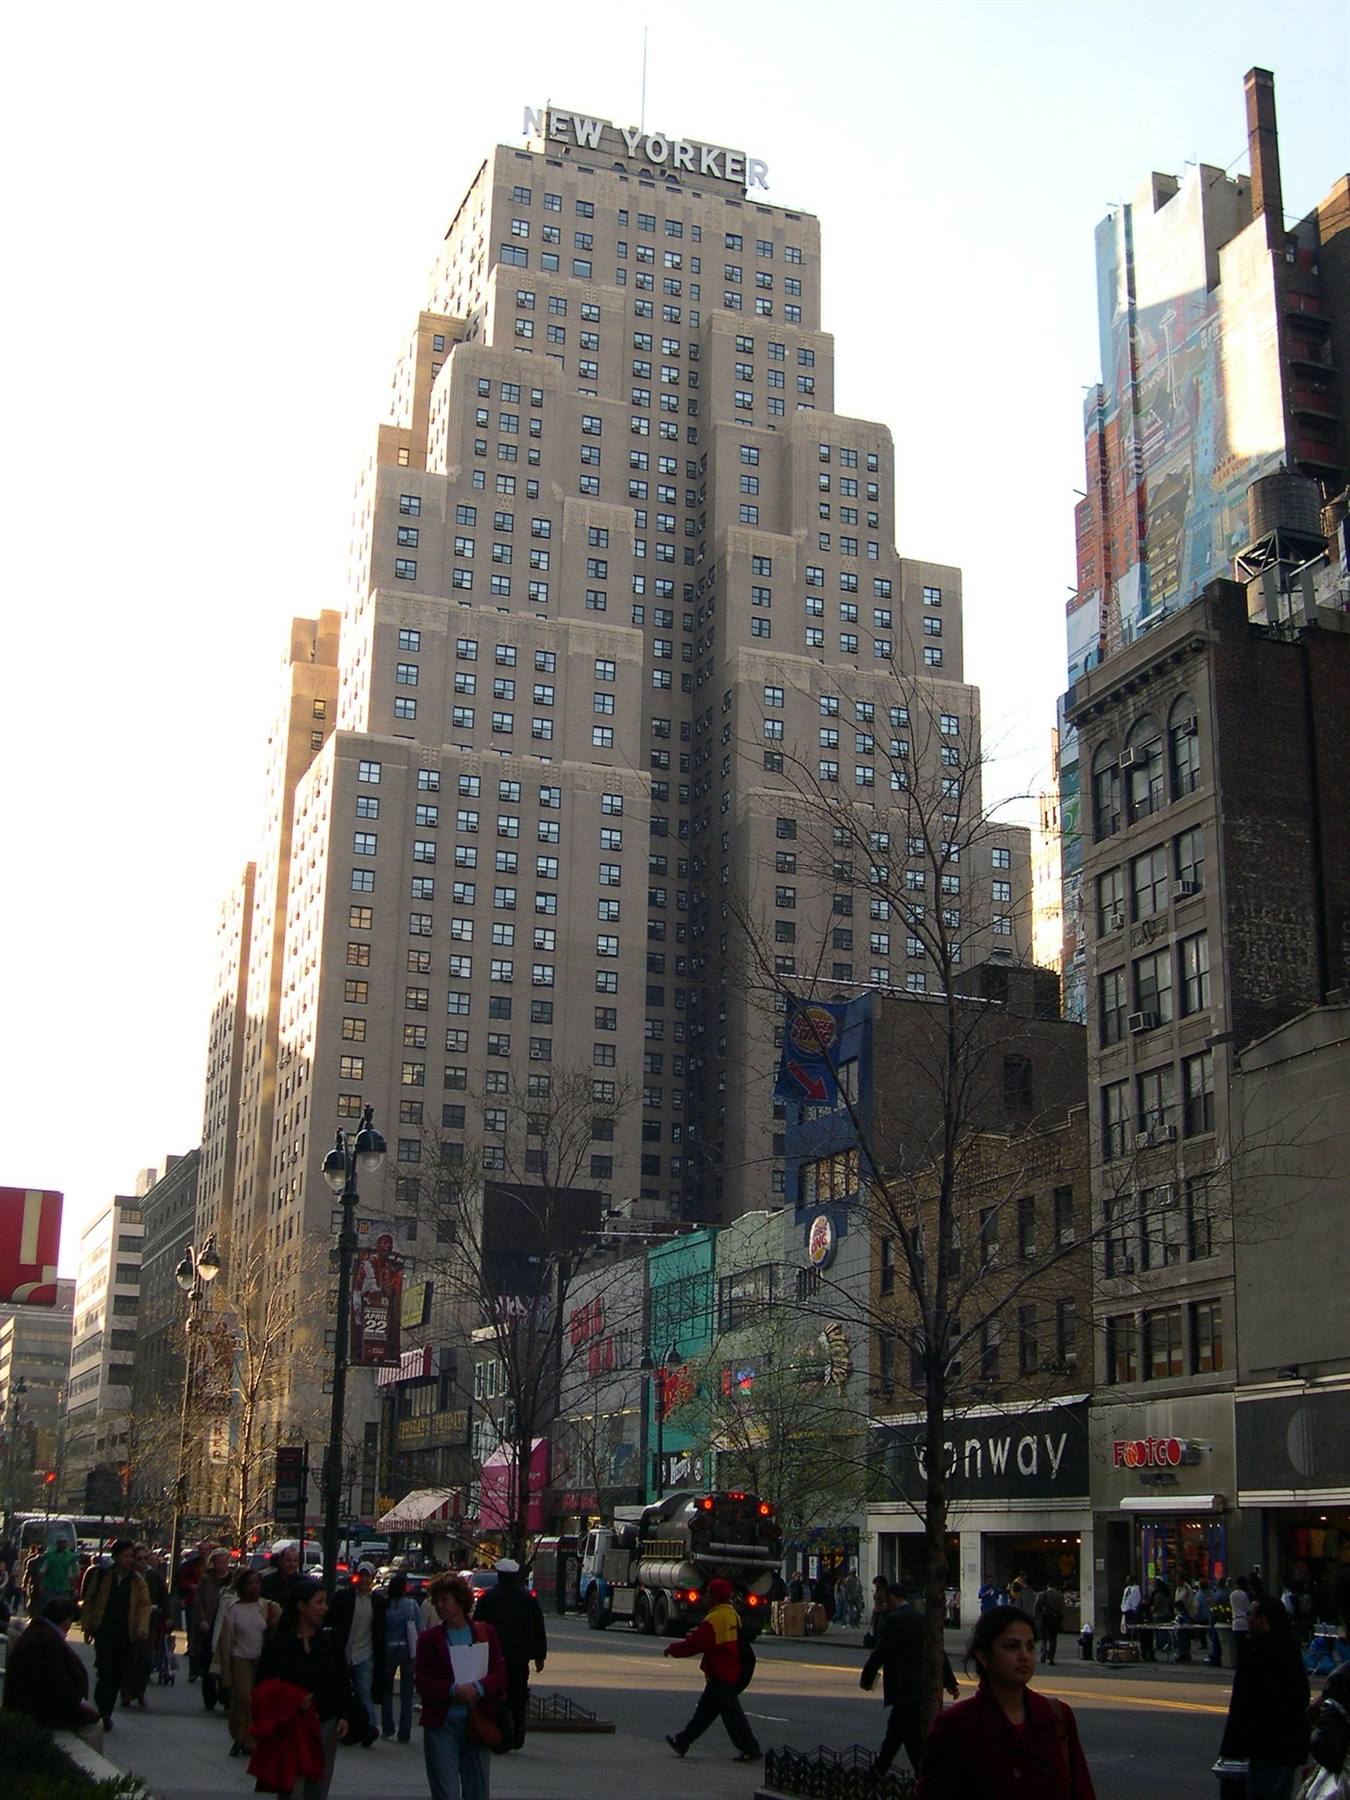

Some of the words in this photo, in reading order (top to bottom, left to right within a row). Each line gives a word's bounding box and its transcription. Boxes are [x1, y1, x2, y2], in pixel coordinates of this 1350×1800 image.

[522, 106, 604, 149] NEW
[620, 128, 769, 190] YORKER
[364, 1312, 388, 1320] APRIL
[363, 1320, 387, 1333] 22
